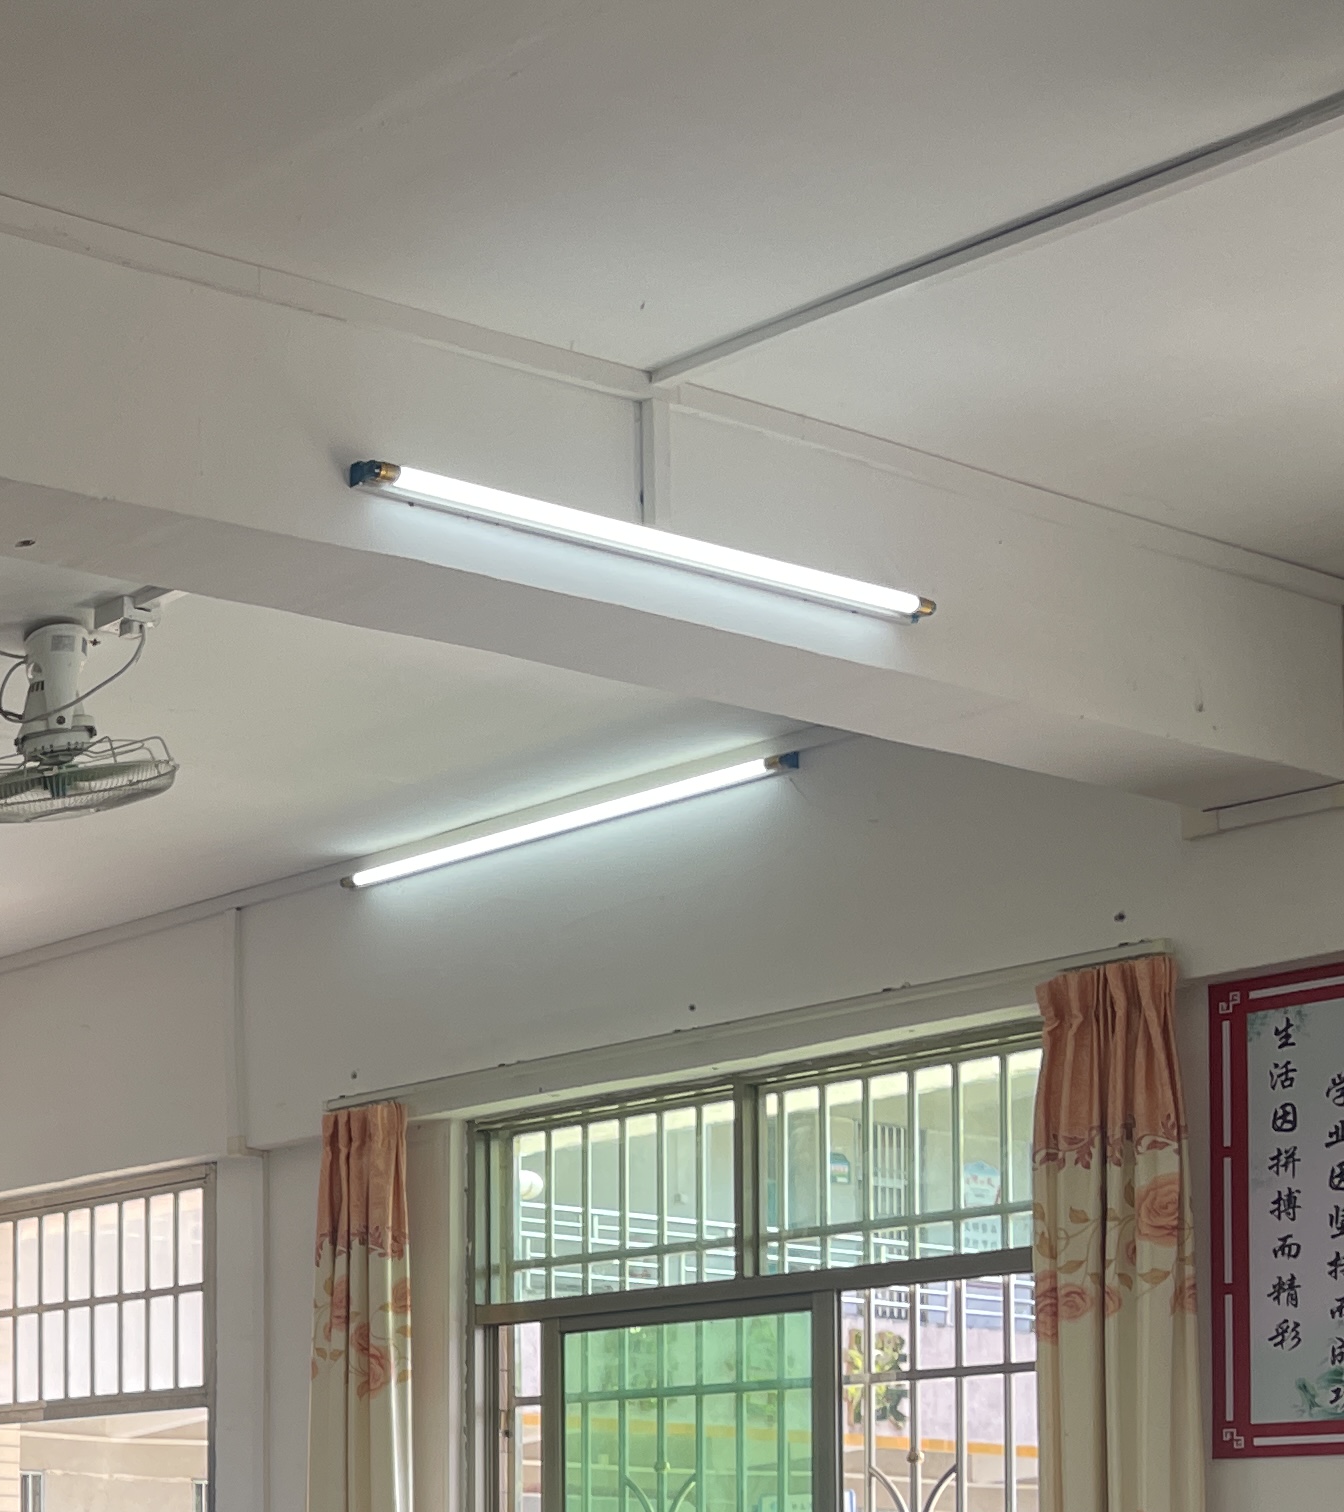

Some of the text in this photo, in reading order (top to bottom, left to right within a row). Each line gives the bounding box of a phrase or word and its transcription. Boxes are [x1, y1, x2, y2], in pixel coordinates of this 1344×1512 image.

[1266, 1016, 1302, 1352] 生活因拼搏而精彩
